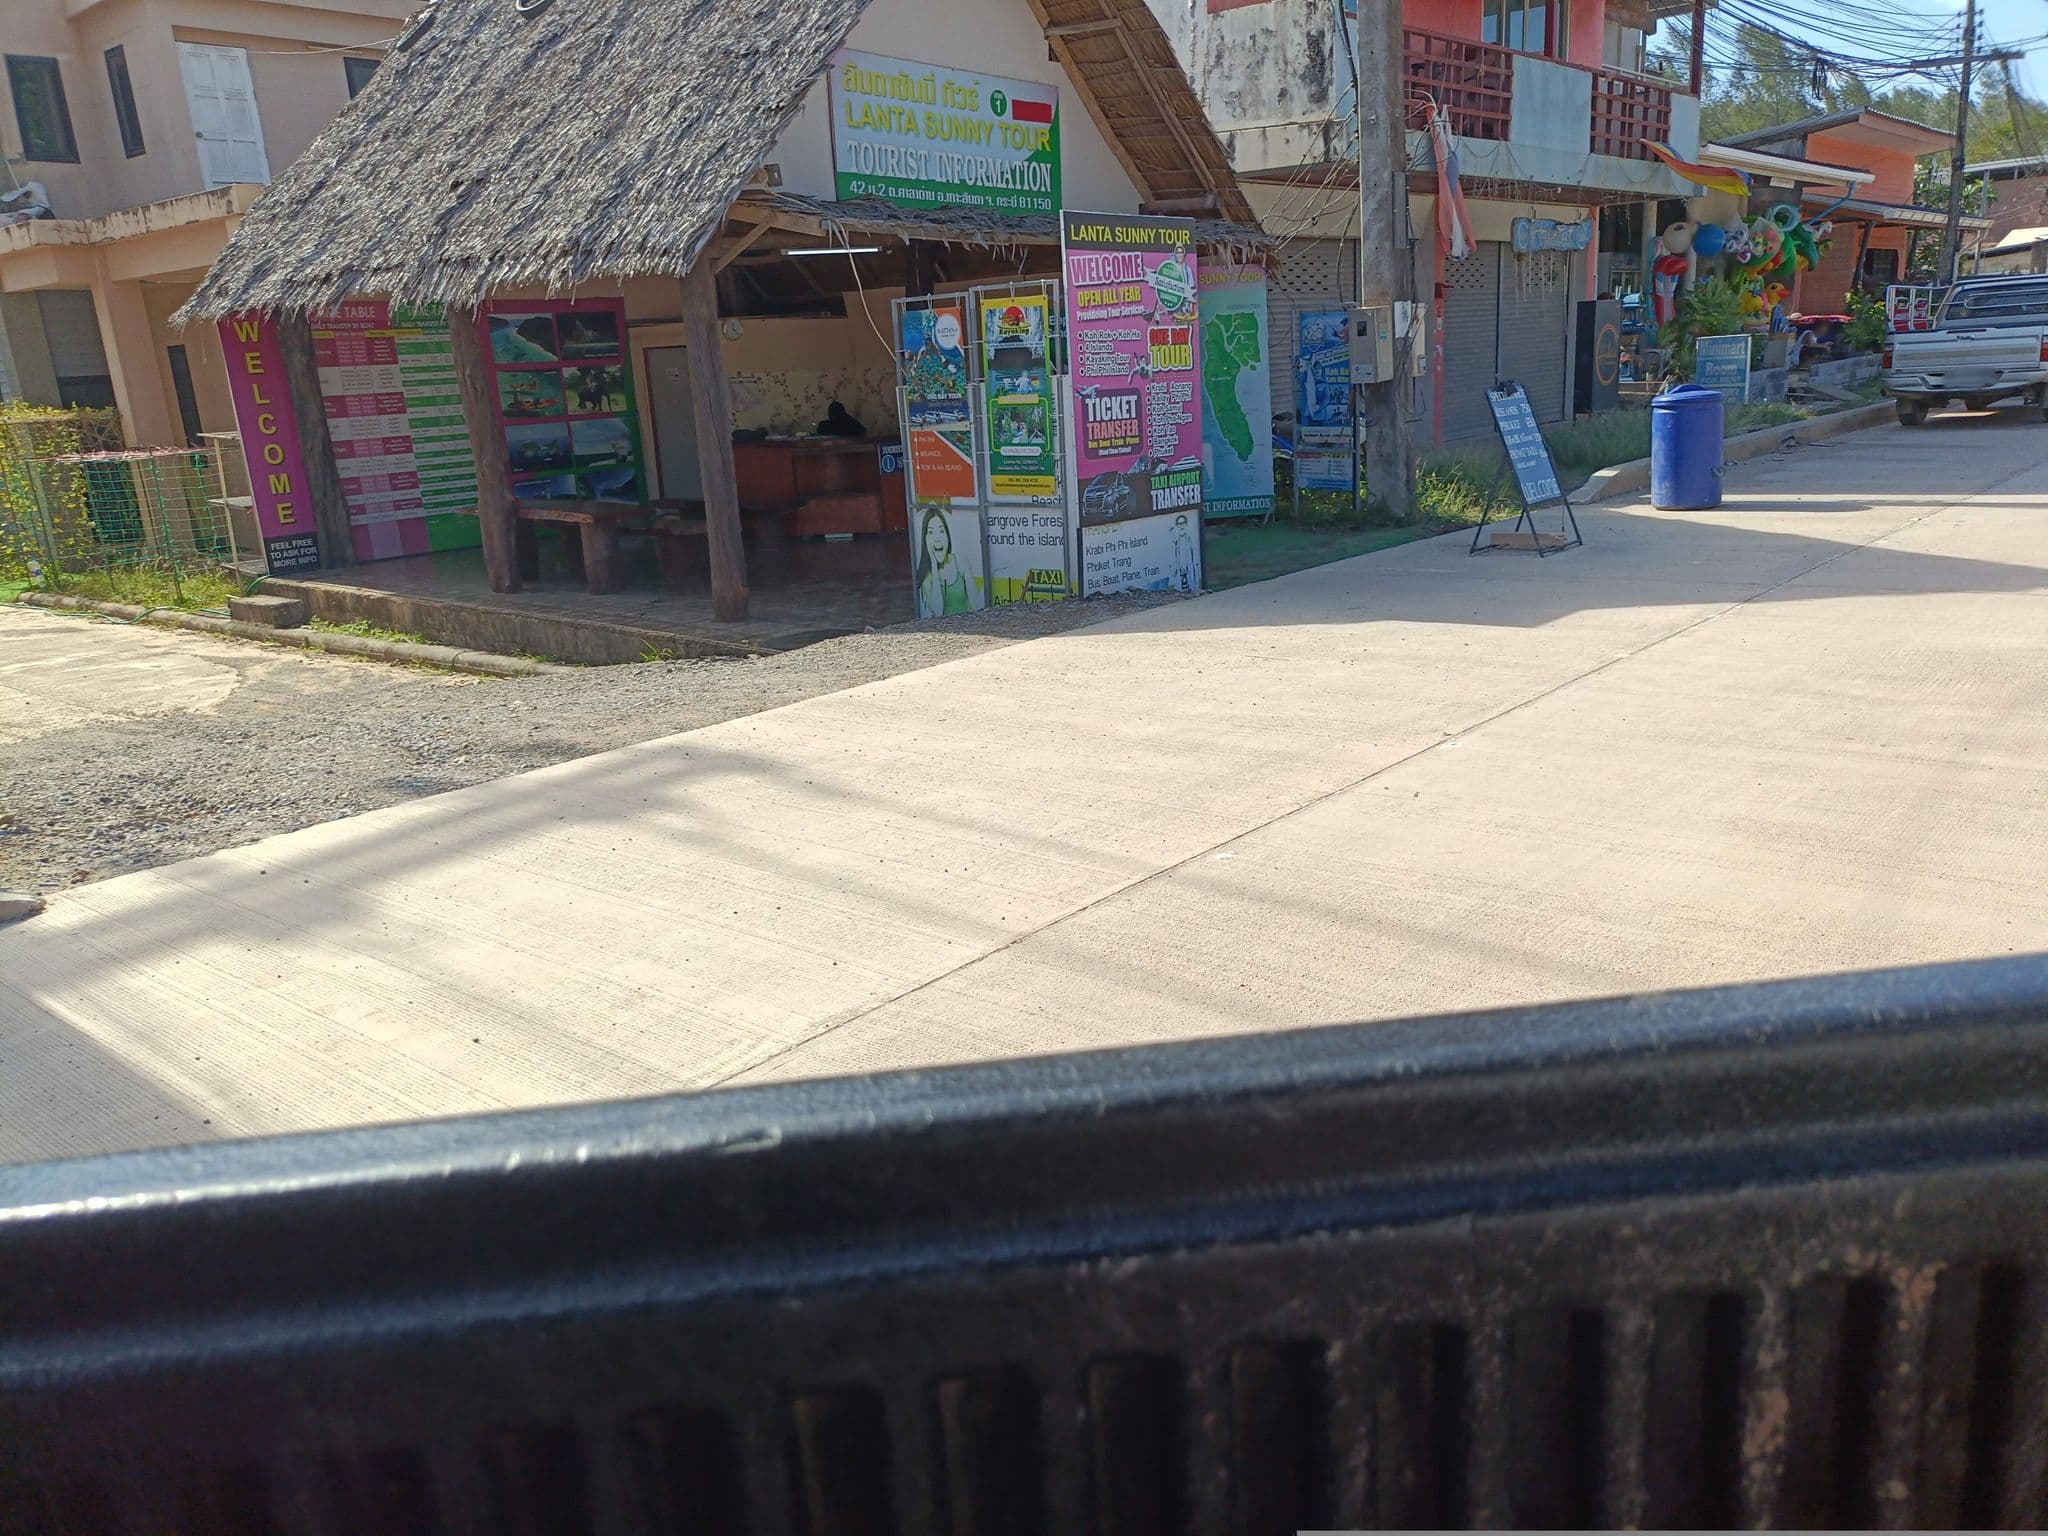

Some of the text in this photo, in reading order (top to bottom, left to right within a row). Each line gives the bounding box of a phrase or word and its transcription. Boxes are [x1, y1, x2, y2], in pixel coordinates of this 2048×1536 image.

[995, 99, 1002, 113] 1
[844, 99, 1052, 152] LANTA SUNNY TOUR
[846, 140, 1052, 192] TOURIST INFORMATION
[850, 180, 866, 194] 42
[1019, 196, 1052, 211] 81150
[1070, 224, 1190, 245] LANTA SUNNY TOUR
[1070, 253, 1143, 285] WELCOME
[1199, 273, 1232, 285] SUNNY
[1235, 271, 1262, 283] TOUR
[1078, 285, 1142, 307] OPEN ALL YEAR
[344, 306, 377, 318] TABLE
[1083, 329, 1098, 341] Koh
[1118, 329, 1131, 340] Koh
[1149, 327, 1190, 345] ONE DAY
[1091, 341, 1113, 352] Islands
[1699, 342, 1745, 356] Minimart
[1085, 352, 1130, 365] Kayaking Tour
[1150, 344, 1191, 370] TOUR
[1086, 363, 1129, 376] Phi Phi Island
[1705, 362, 1738, 376] Room
[1151, 382, 1167, 393] Krabi
[1085, 395, 1137, 422] TICKET
[1152, 404, 1165, 414] Koh
[232, 320, 297, 526] WELCOME
[1152, 415, 1165, 425] Koh
[1087, 419, 1139, 441] TRANSFER
[1153, 425, 1176, 436] Koh Tao
[1153, 435, 1178, 447] Bangkok
[1153, 446, 1175, 458] Phuket
[1151, 470, 1201, 490] TAXI AIRPORT
[1151, 484, 1201, 511] TRANSFER
[1213, 497, 1271, 512] INFORMATION
[270, 538, 314, 551] FEEL FREE
[1019, 533, 1035, 546] the
[1085, 535, 1149, 556] Krabi Phi Phi Island
[270, 546, 319, 560] TO ASK FOR
[273, 555, 318, 568] MORE INFO
[1086, 556, 1132, 573] Phuket Trang
[1032, 570, 1062, 585] TAXI
